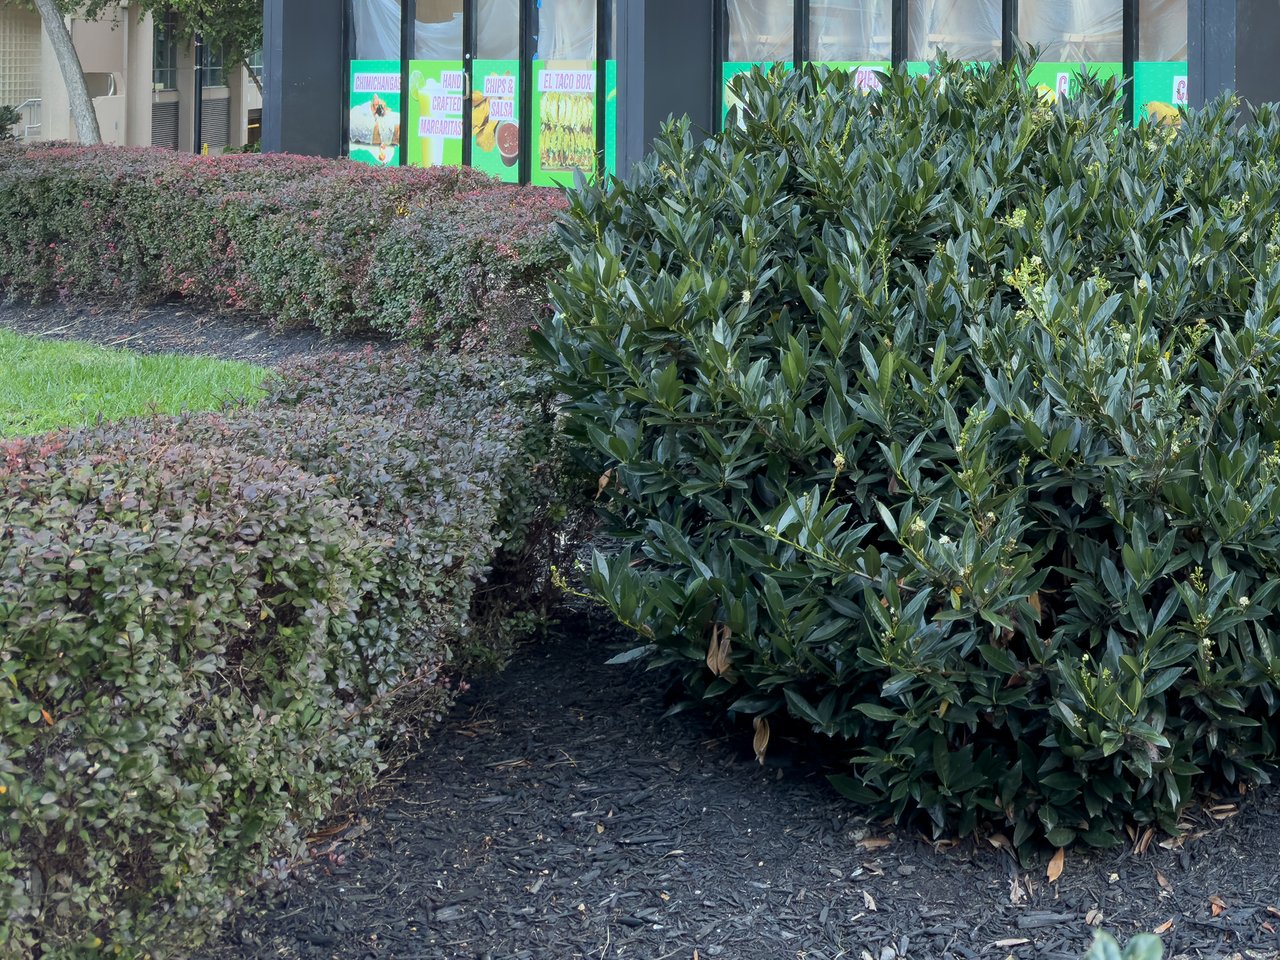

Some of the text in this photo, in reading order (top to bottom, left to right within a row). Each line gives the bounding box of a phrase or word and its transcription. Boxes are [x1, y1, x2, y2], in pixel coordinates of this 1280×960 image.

[355, 75, 401, 91] CHIMICHANGAS
[442, 73, 462, 89] HAND
[485, 77, 514, 94] CHIPS &
[543, 73, 593, 90] EL TACO BOX
[432, 96, 462, 112] CRAFTED
[491, 101, 513, 118] SALSA
[420, 119, 463, 136] MARGARITAS
